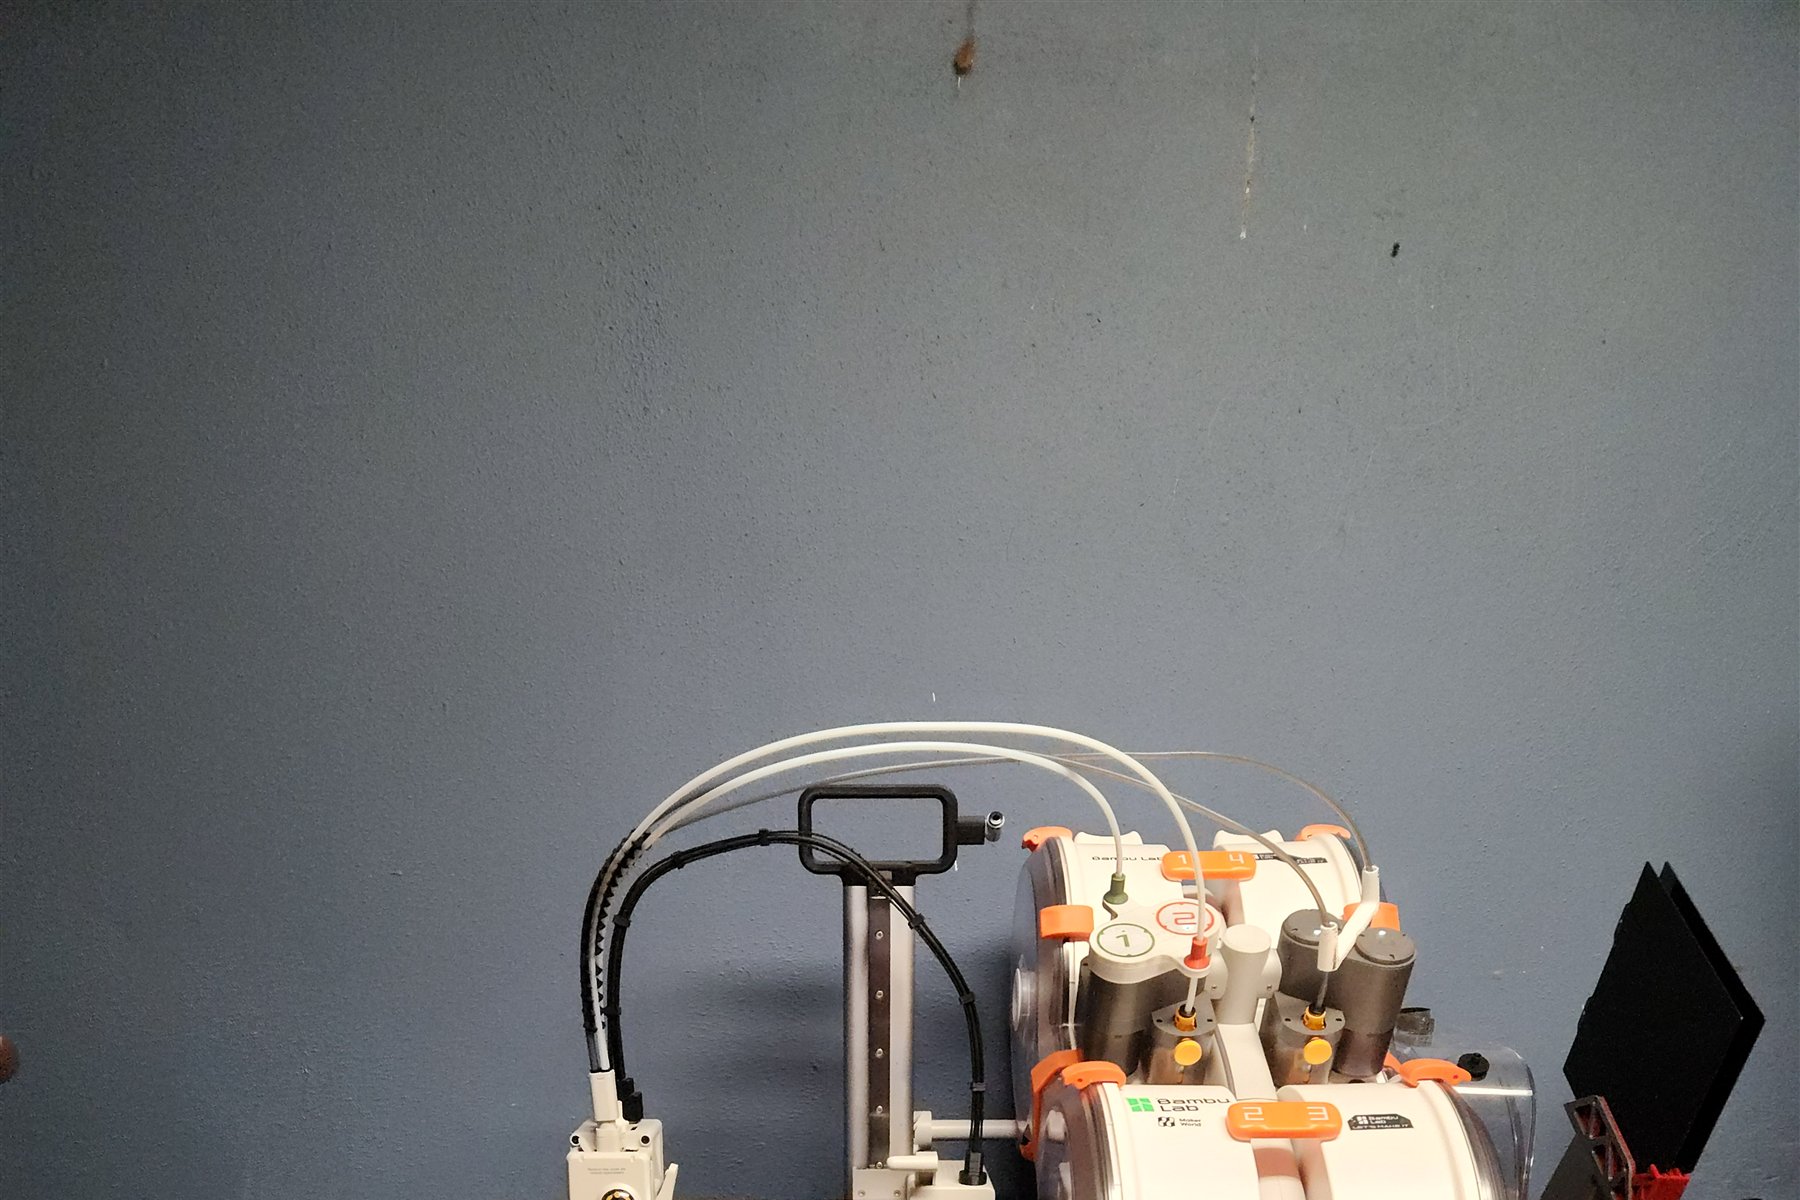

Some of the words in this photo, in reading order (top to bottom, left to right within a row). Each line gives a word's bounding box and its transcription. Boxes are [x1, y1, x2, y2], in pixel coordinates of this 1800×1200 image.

[1178, 854, 1188, 865] 1
[1228, 853, 1246, 865] 4
[1172, 911, 1197, 926] 2
[1116, 933, 1131, 948] 1
[1157, 1097, 1231, 1105] Bambu
[1159, 1104, 1199, 1112] Lab
[1242, 1106, 1265, 1121] 2
[1306, 1106, 1330, 1121] 3
